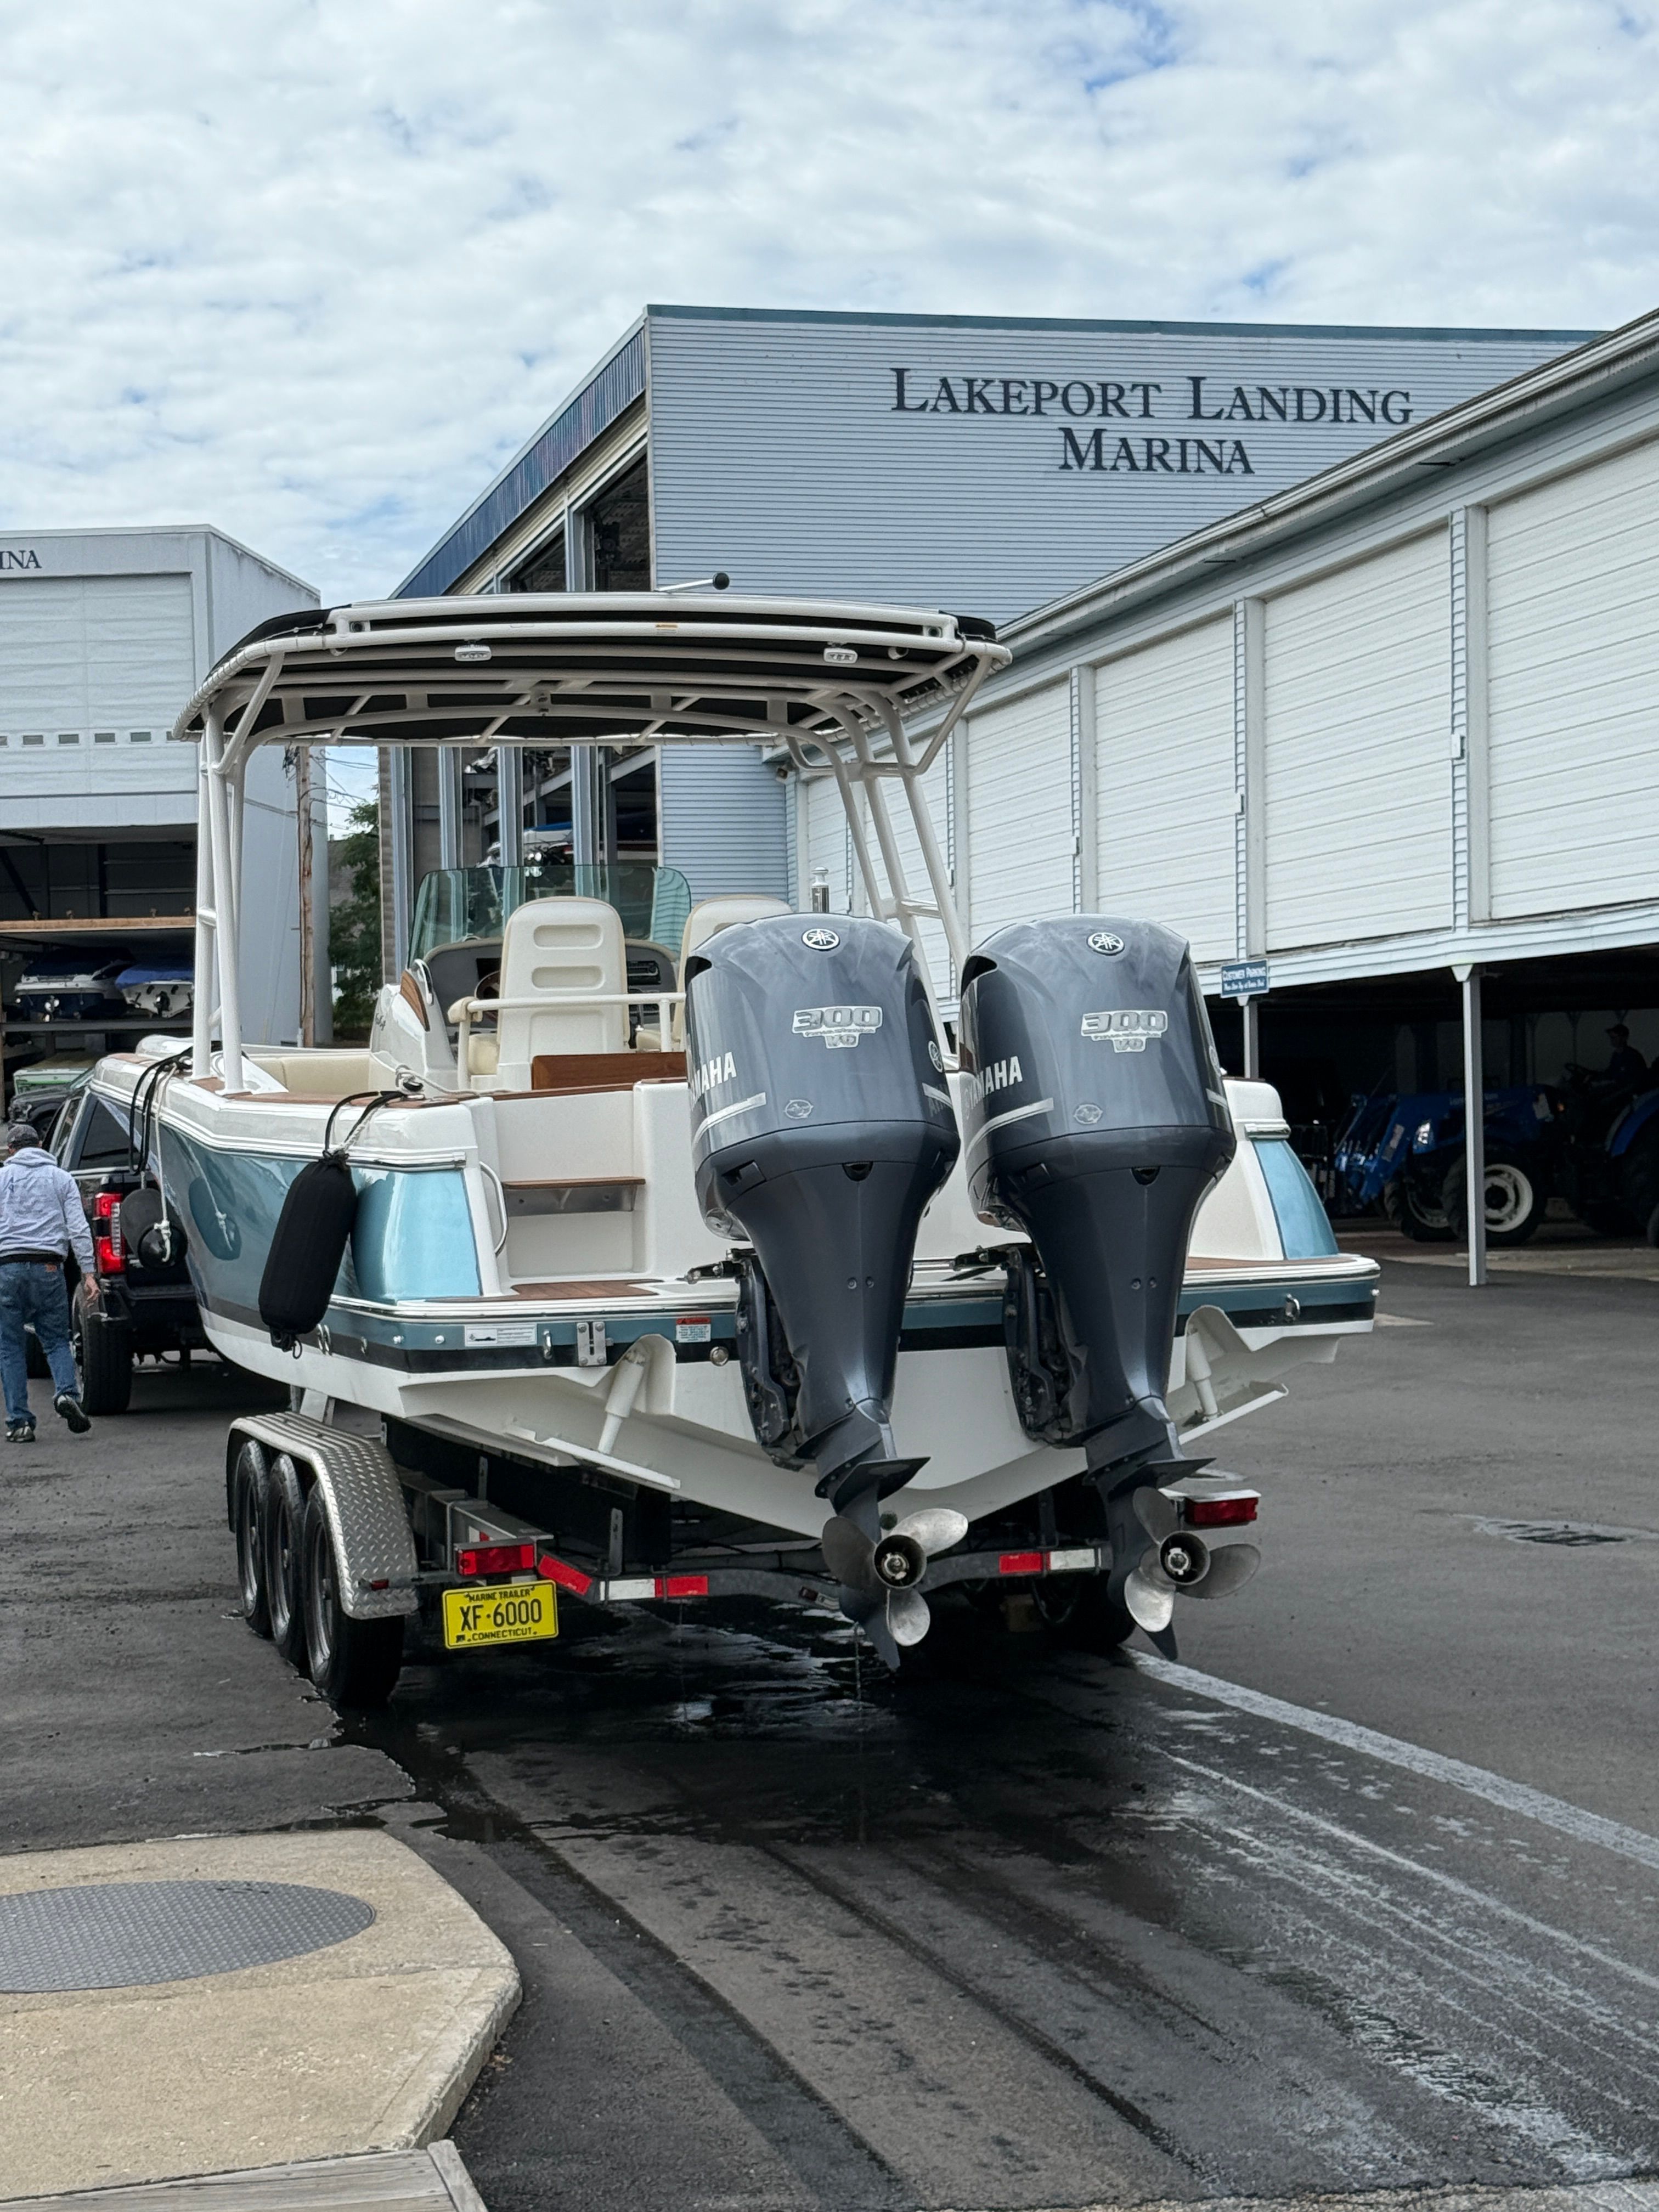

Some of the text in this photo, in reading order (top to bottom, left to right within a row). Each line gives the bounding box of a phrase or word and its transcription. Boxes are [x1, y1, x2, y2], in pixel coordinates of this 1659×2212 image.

[890, 368, 1413, 426] LAKEPORT LANDING
[1058, 427, 1255, 474] MARINA
[794, 1008, 881, 1032] 300
[1082, 1011, 1166, 1035] 300
[468, 1588, 531, 1602] MARINE TRAILER
[472, 1627, 532, 1641] CONNECTICUT
